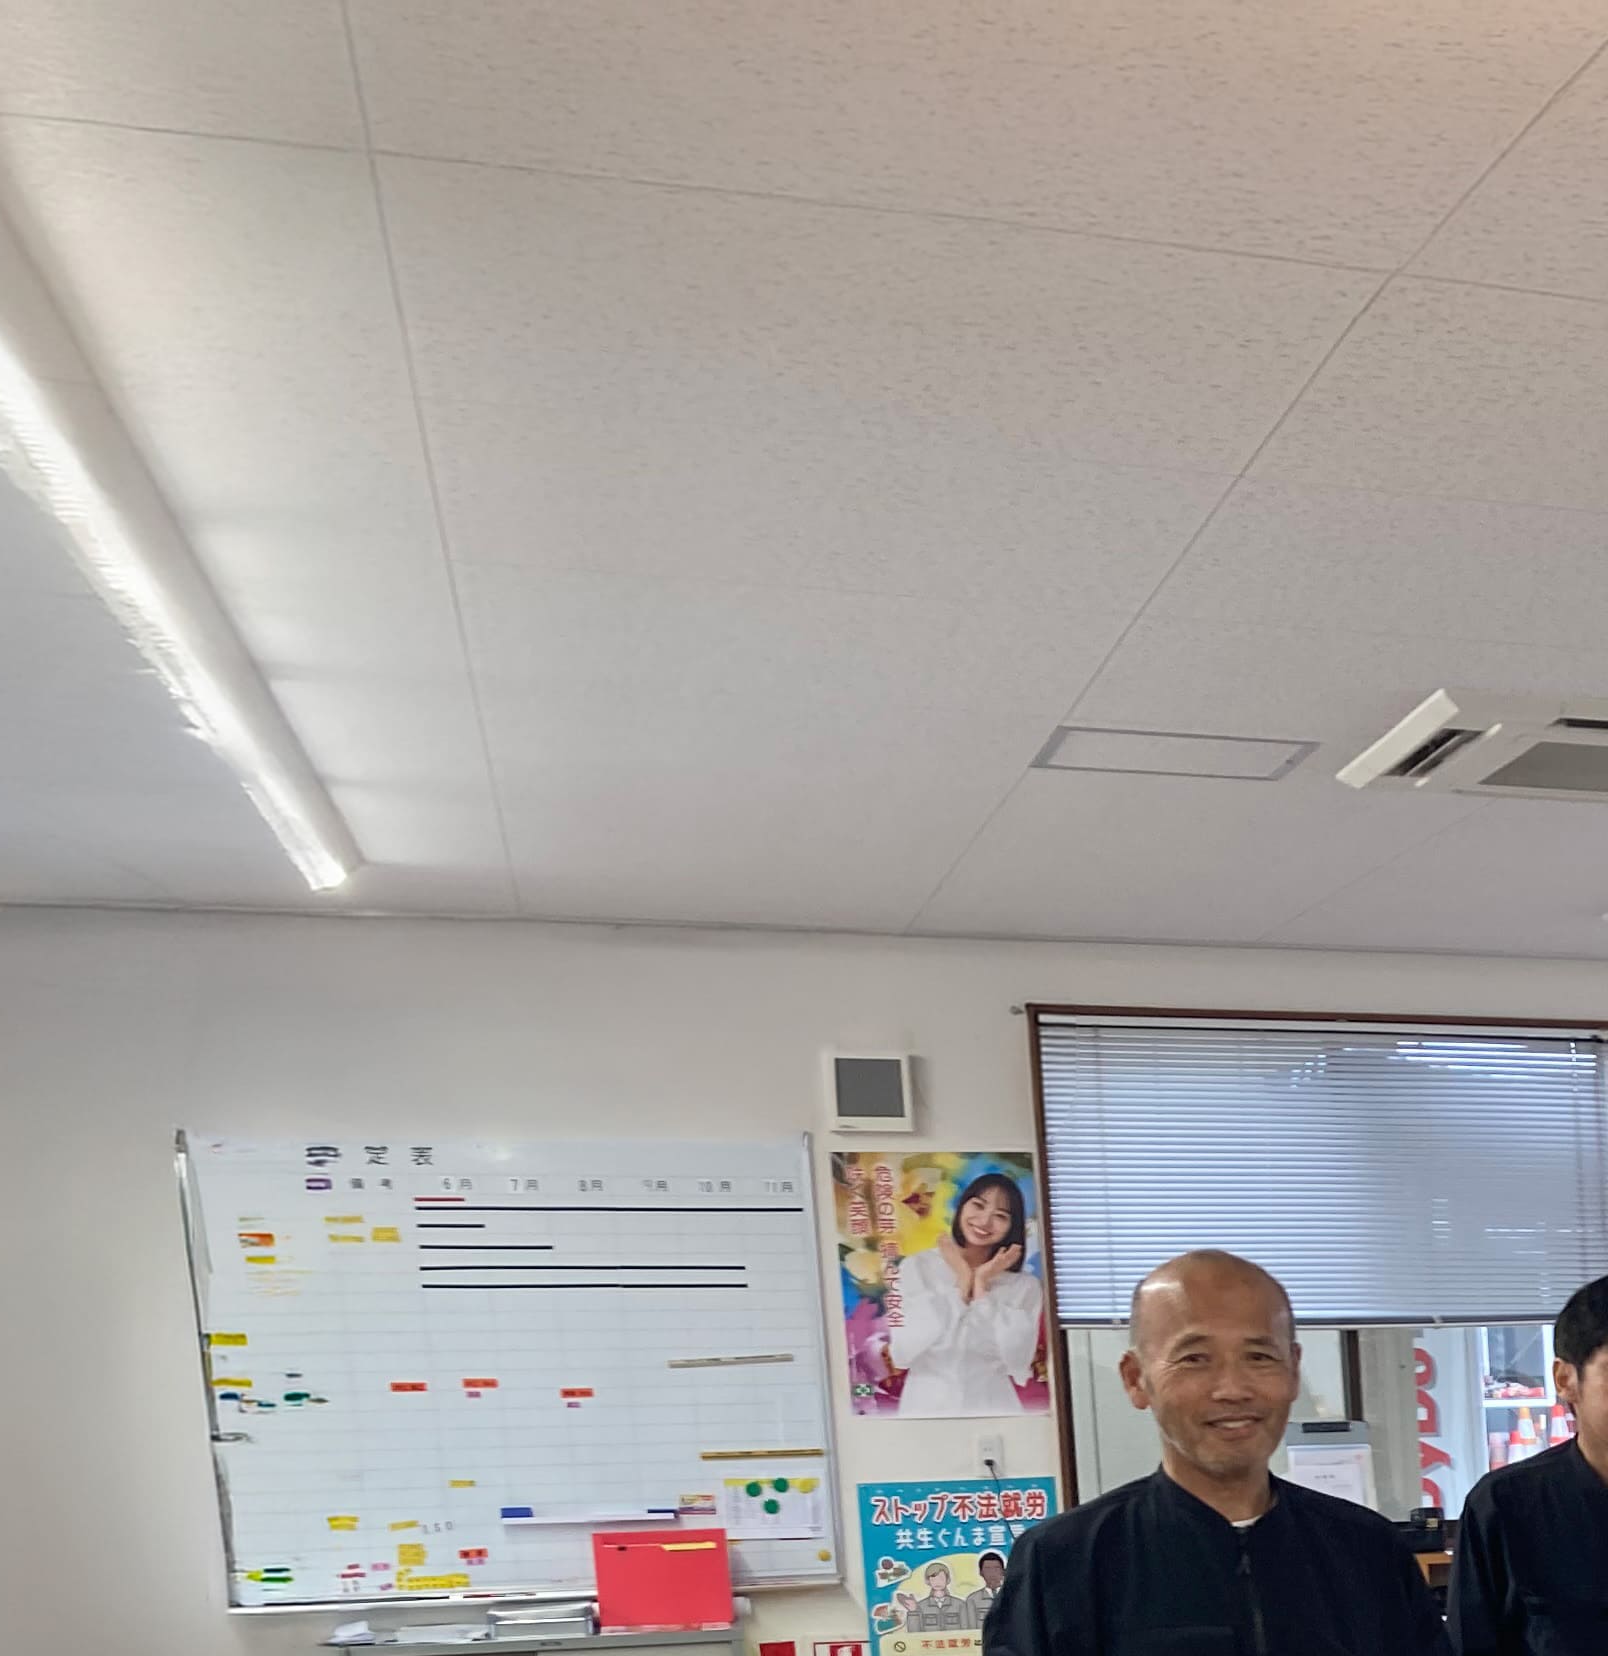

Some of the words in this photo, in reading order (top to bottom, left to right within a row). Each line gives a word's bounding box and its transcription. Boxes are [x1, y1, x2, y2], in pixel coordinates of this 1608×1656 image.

[442, 1177, 472, 1190] 6月
[508, 1178, 539, 1191] 7月
[872, 1490, 1046, 1525] ストップ不法就労
